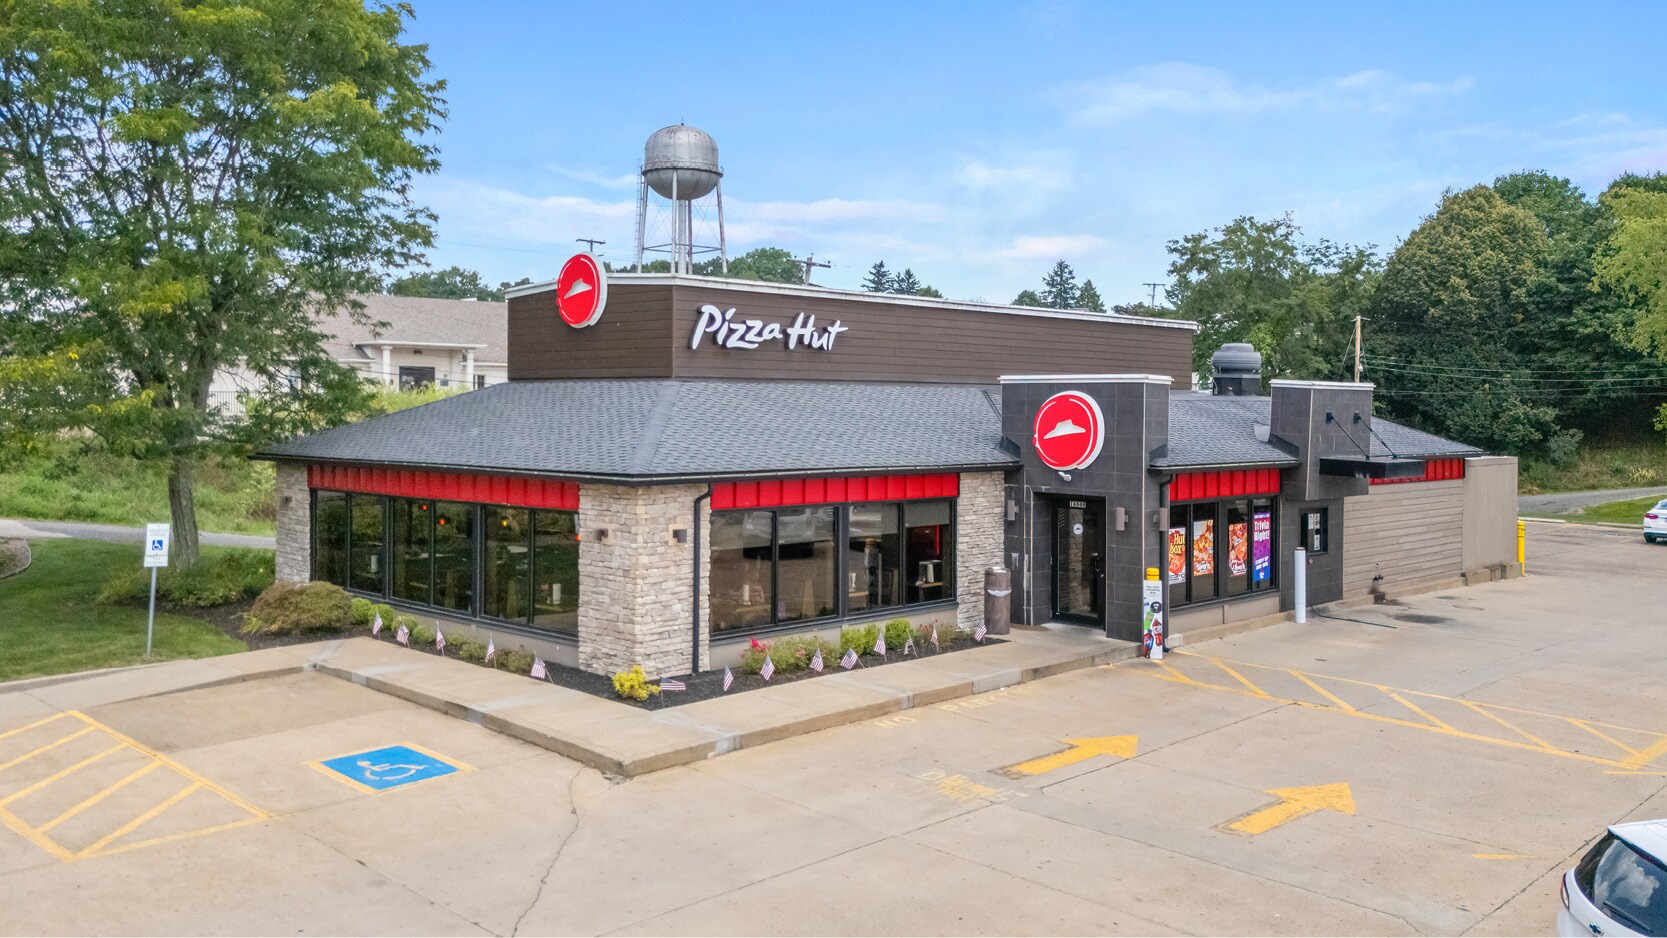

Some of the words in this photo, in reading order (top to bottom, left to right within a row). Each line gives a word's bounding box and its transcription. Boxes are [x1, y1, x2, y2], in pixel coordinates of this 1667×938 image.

[689, 304, 783, 350] Pizza
[785, 312, 849, 350] Hut
[1254, 521, 1270, 531] Trivia
[873, 715, 916, 729] NO
